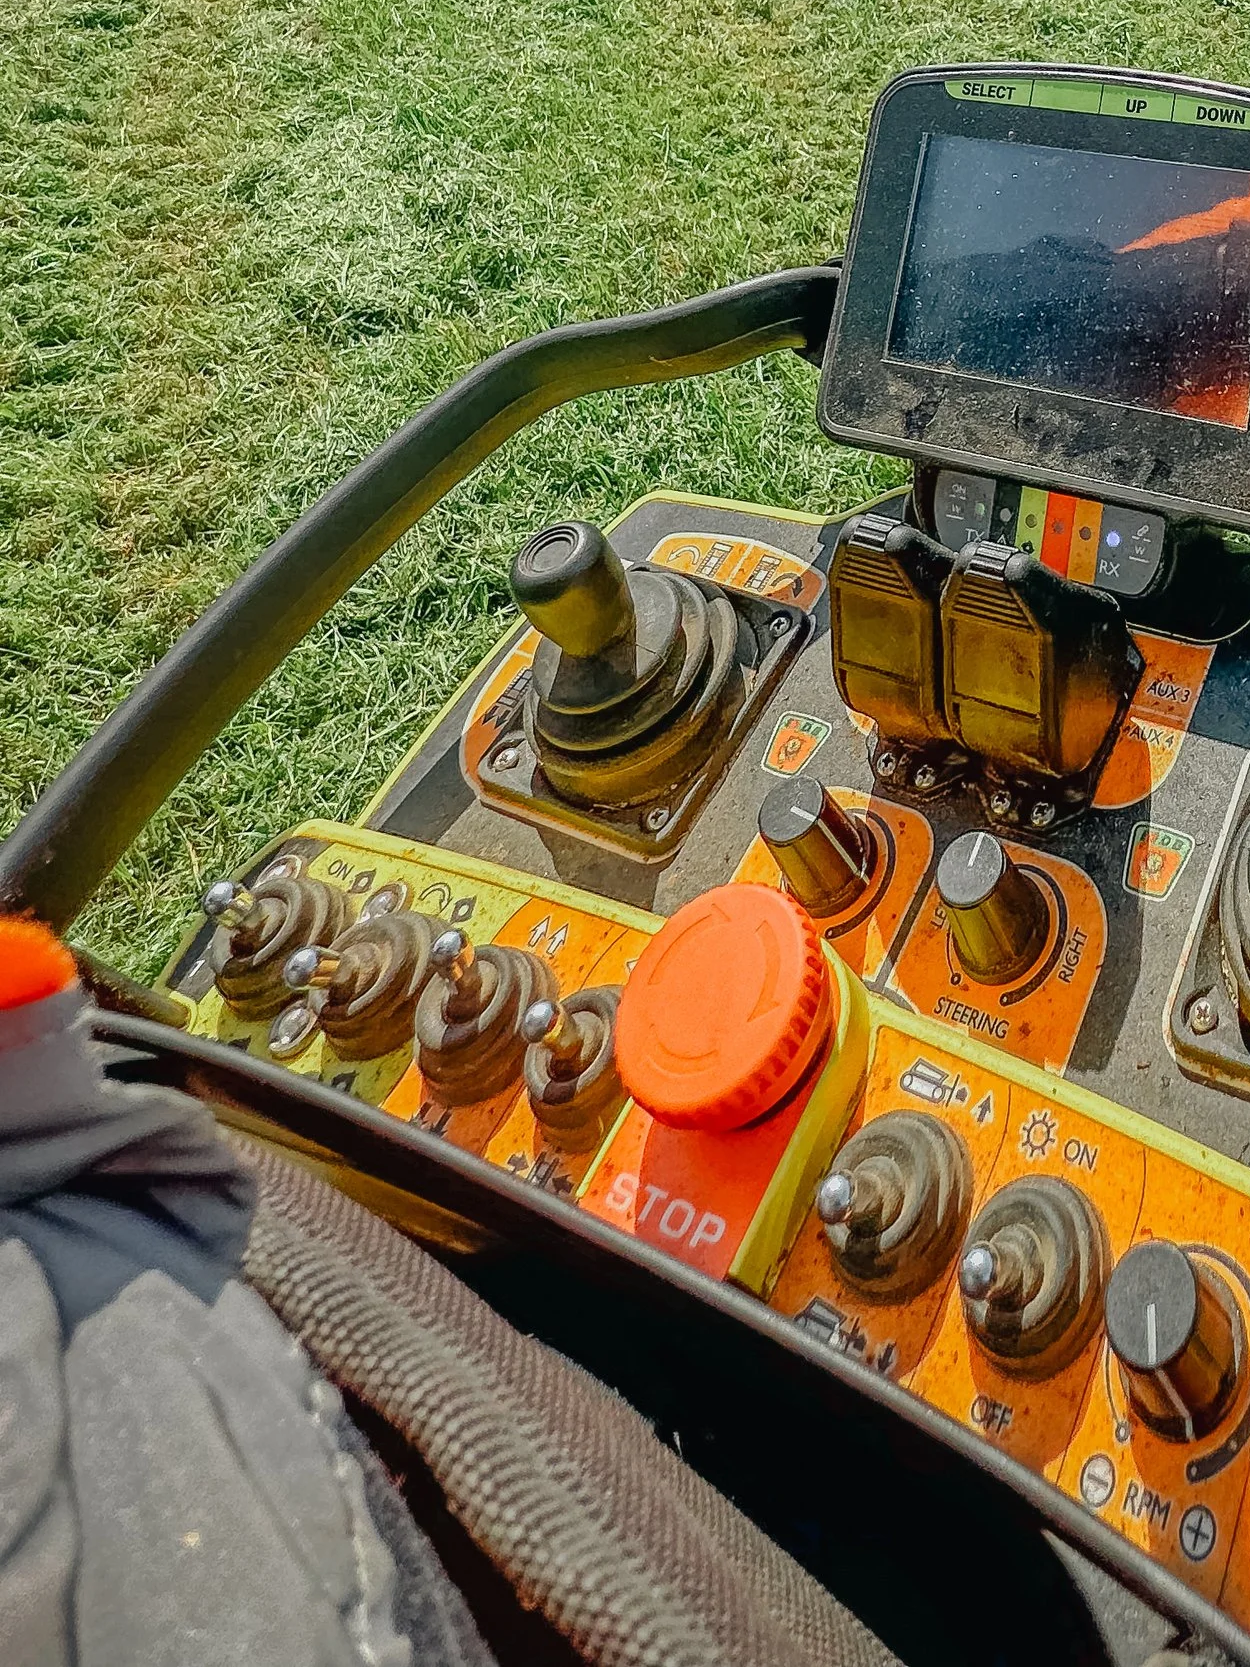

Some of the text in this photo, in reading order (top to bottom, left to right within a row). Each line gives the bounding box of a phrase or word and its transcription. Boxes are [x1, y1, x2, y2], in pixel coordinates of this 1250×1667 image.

[961, 81, 1016, 101] SELECT
[1125, 98, 1147, 114] UP
[1196, 105, 1246, 125] DOWN
[965, 528, 985, 542] TX
[1099, 559, 1121, 578] RX
[1146, 681, 1190, 703] AUX 3
[1132, 724, 1175, 748] AUX 4
[328, 859, 355, 881] ON
[1057, 926, 1088, 984] RIGHT
[933, 996, 1010, 1039] STEERING
[1064, 1138, 1098, 1171] ON
[605, 1172, 726, 1249] STOP
[970, 1394, 1014, 1434] OFF
[1122, 1478, 1172, 1532] RPM
